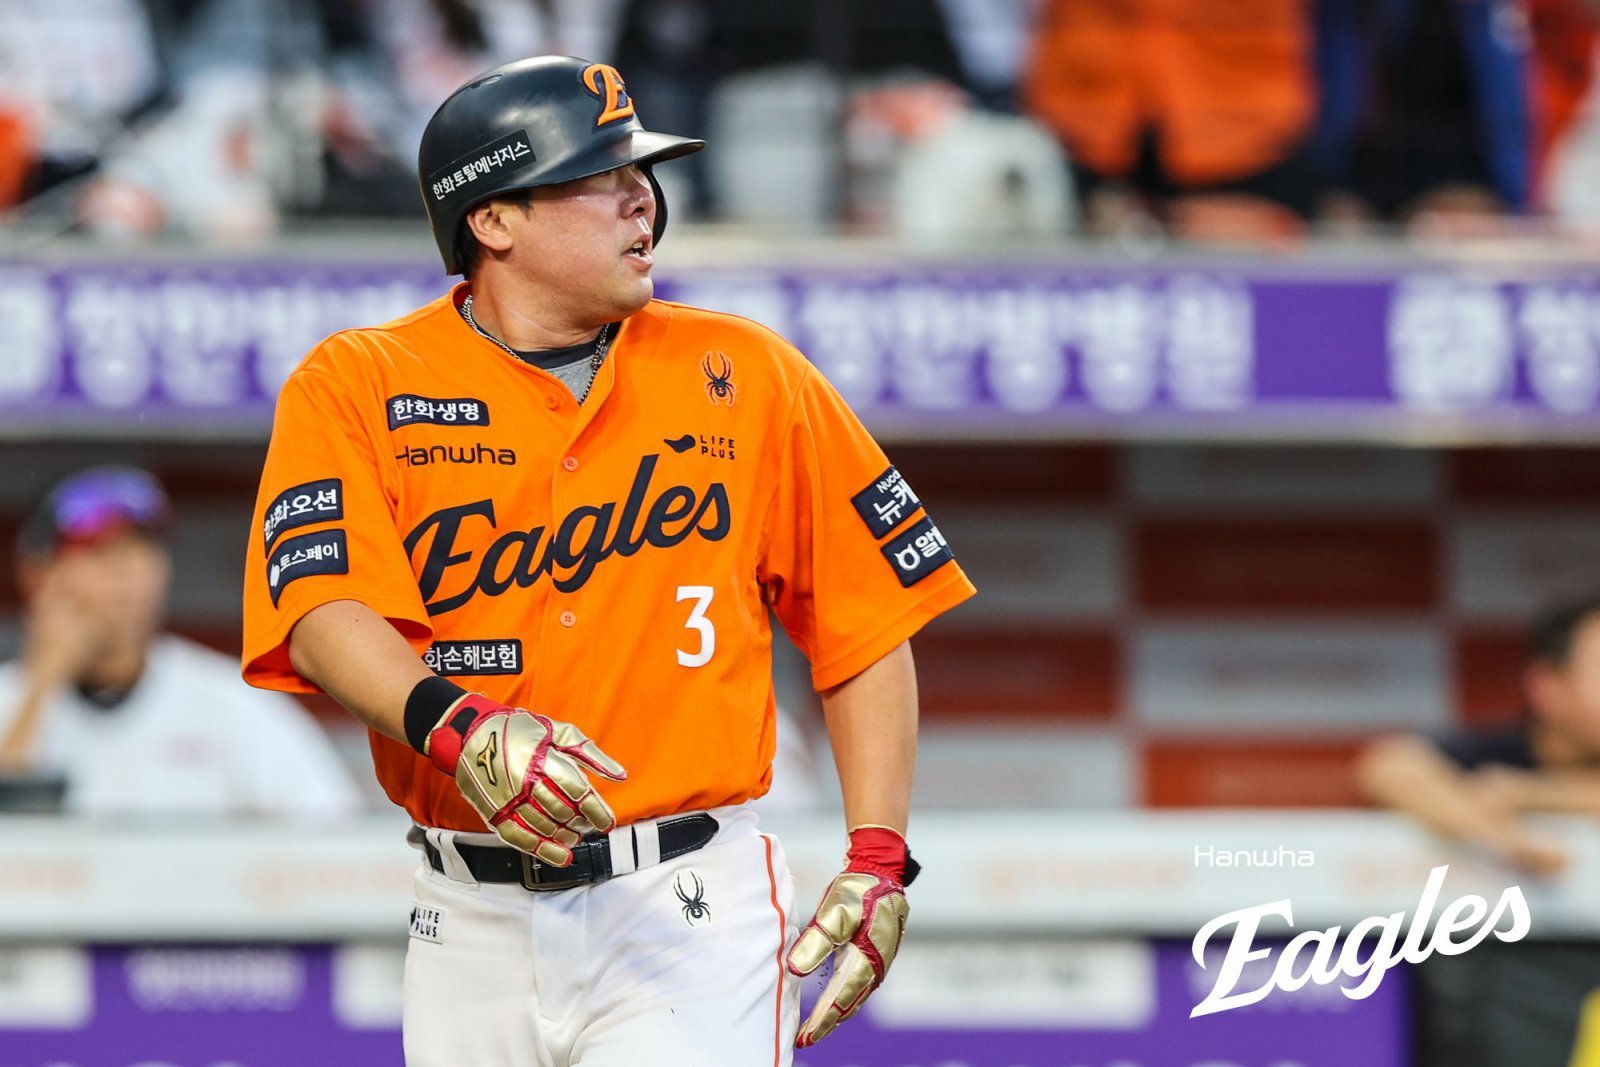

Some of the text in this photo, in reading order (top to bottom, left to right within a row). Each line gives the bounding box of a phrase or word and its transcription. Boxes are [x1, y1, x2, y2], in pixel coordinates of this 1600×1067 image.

[432, 141, 531, 200] 한화토탈에너지스
[392, 398, 480, 422] 한화생명
[395, 442, 516, 467] Hanwha
[700, 434, 735, 449] LIFE
[701, 445, 735, 460] PLUS
[264, 488, 338, 542] 한화오션
[403, 453, 731, 617] Eagles
[280, 542, 339, 572] 토스페이
[675, 585, 715, 668] 3
[417, 907, 440, 924] LIFE
